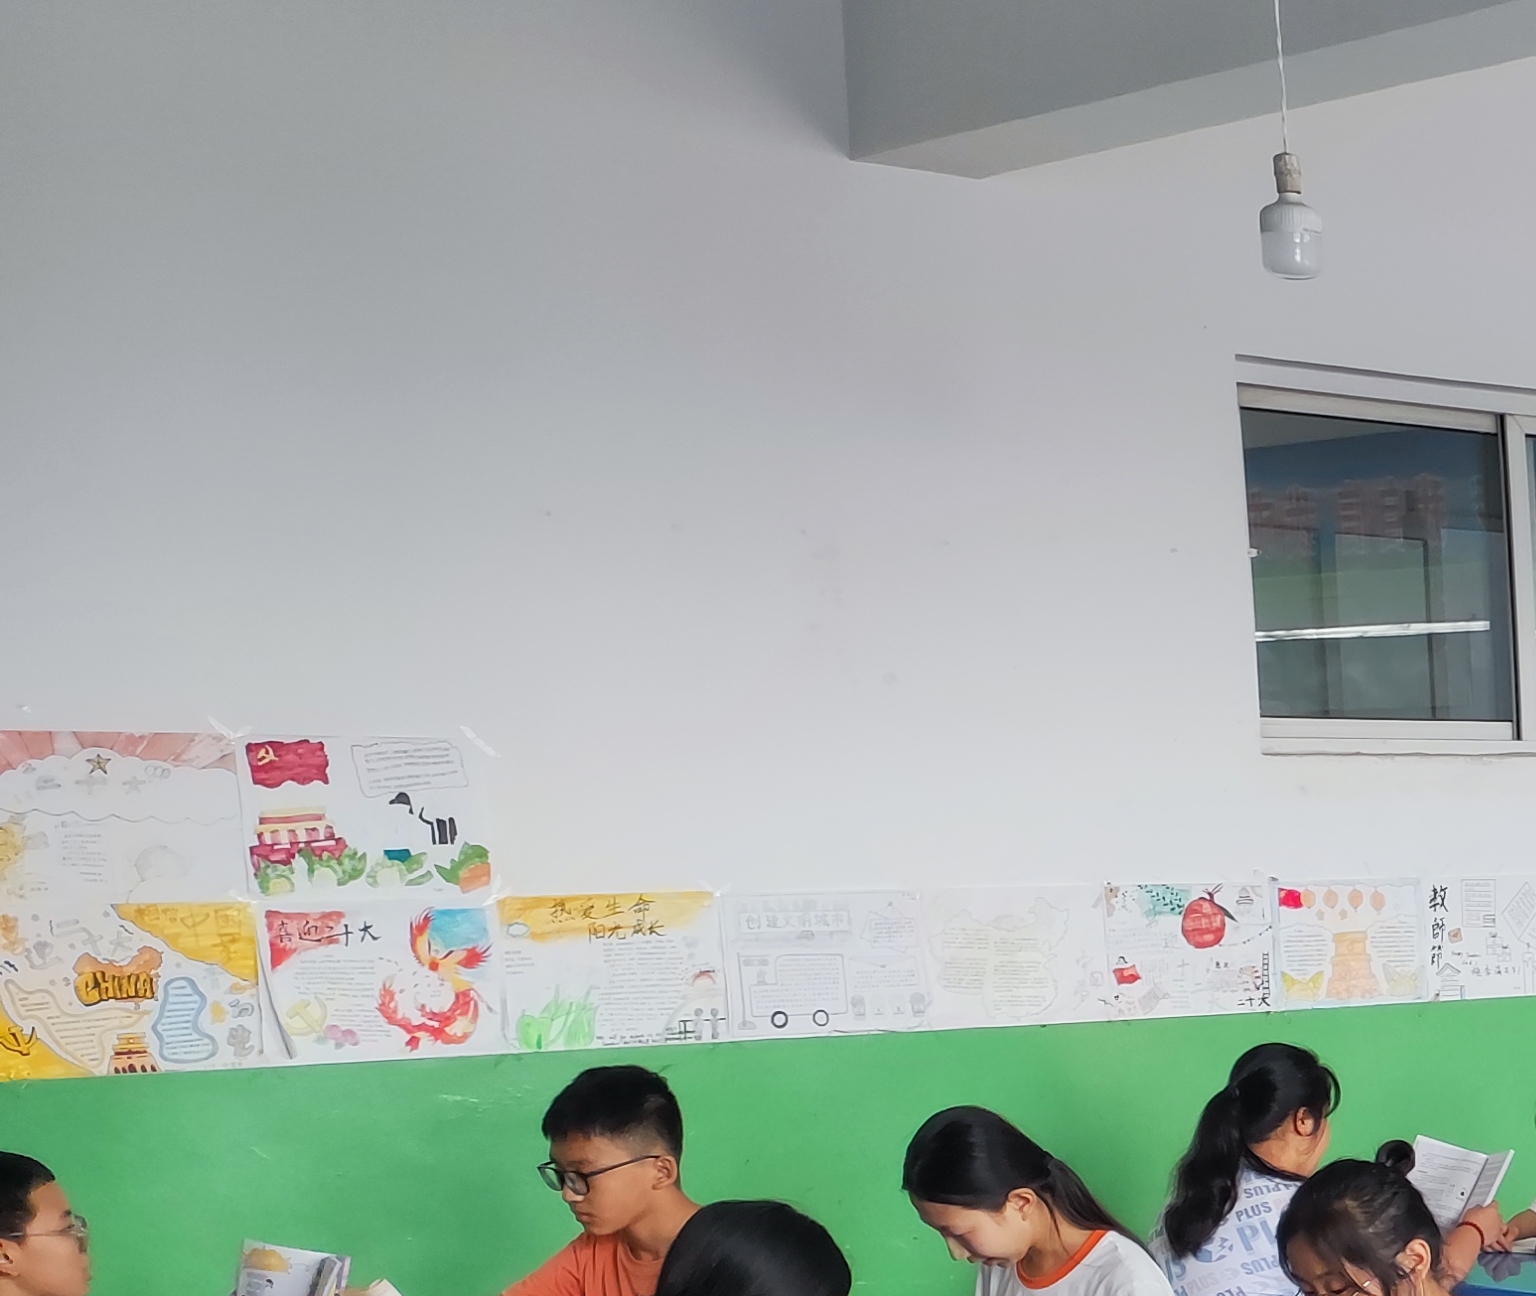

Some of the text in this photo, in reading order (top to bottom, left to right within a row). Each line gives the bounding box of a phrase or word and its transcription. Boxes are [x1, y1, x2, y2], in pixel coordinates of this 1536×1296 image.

[548, 893, 657, 923] 热爱生命
[276, 919, 383, 946] 喜迎二十大
[587, 918, 668, 944] 阳光成长
[1235, 1201, 1272, 1222] PLUS
